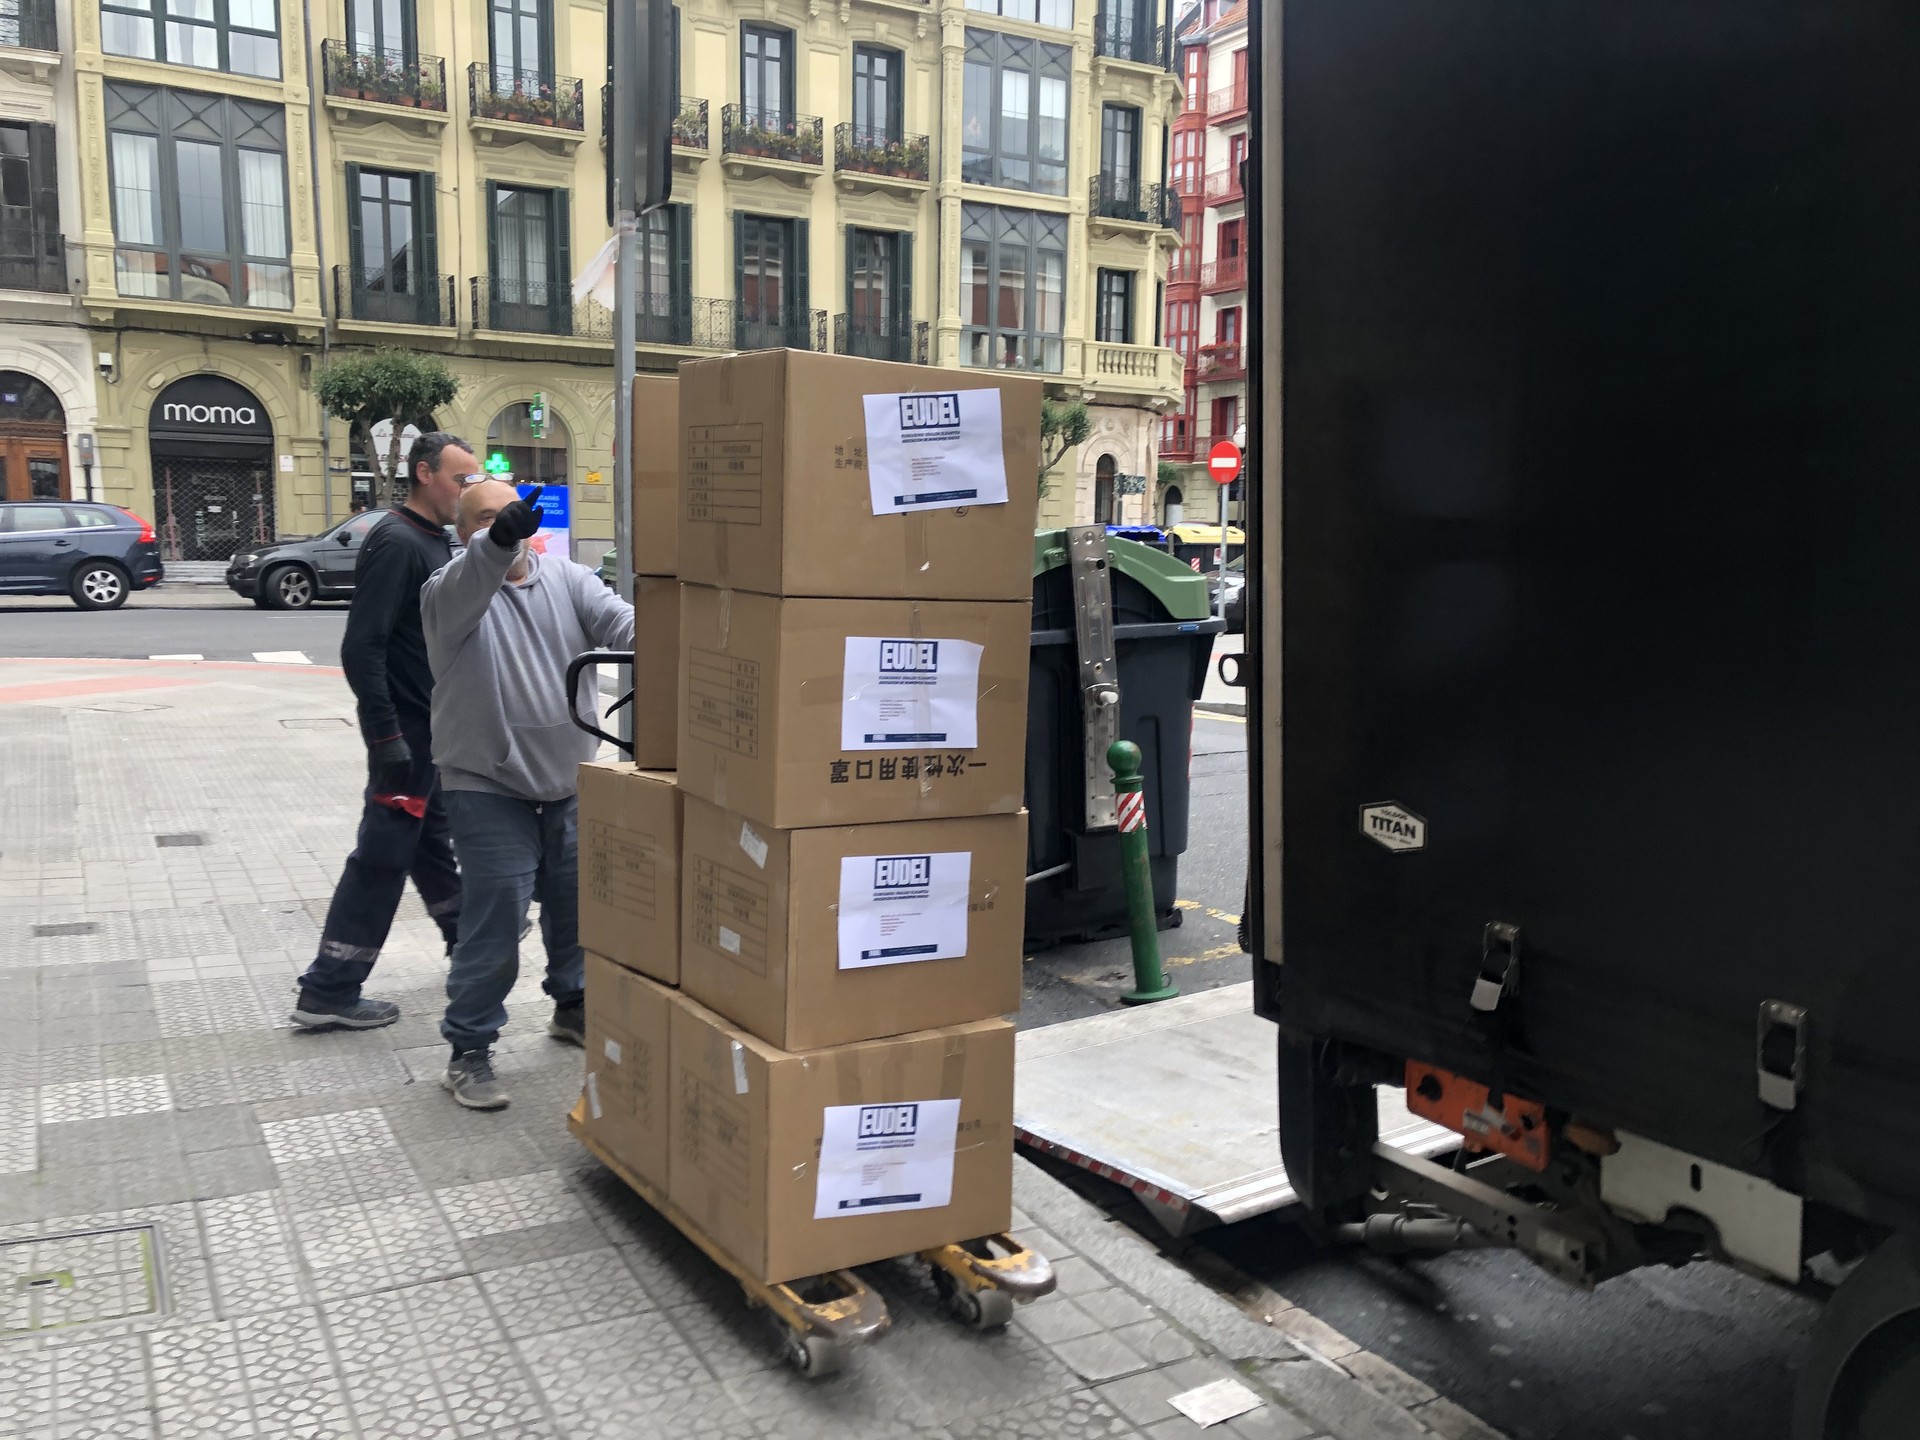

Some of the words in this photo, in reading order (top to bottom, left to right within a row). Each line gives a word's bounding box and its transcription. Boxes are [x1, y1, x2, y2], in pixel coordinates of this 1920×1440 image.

[164, 403, 256, 424] moma
[900, 395, 960, 428] EUDEL
[881, 642, 937, 671] EUDEL
[830, 754, 987, 783] 一次性使用口罩
[1370, 815, 1416, 839] TITAN
[875, 858, 930, 888] EUDEL
[859, 1105, 916, 1138] EUDEL
